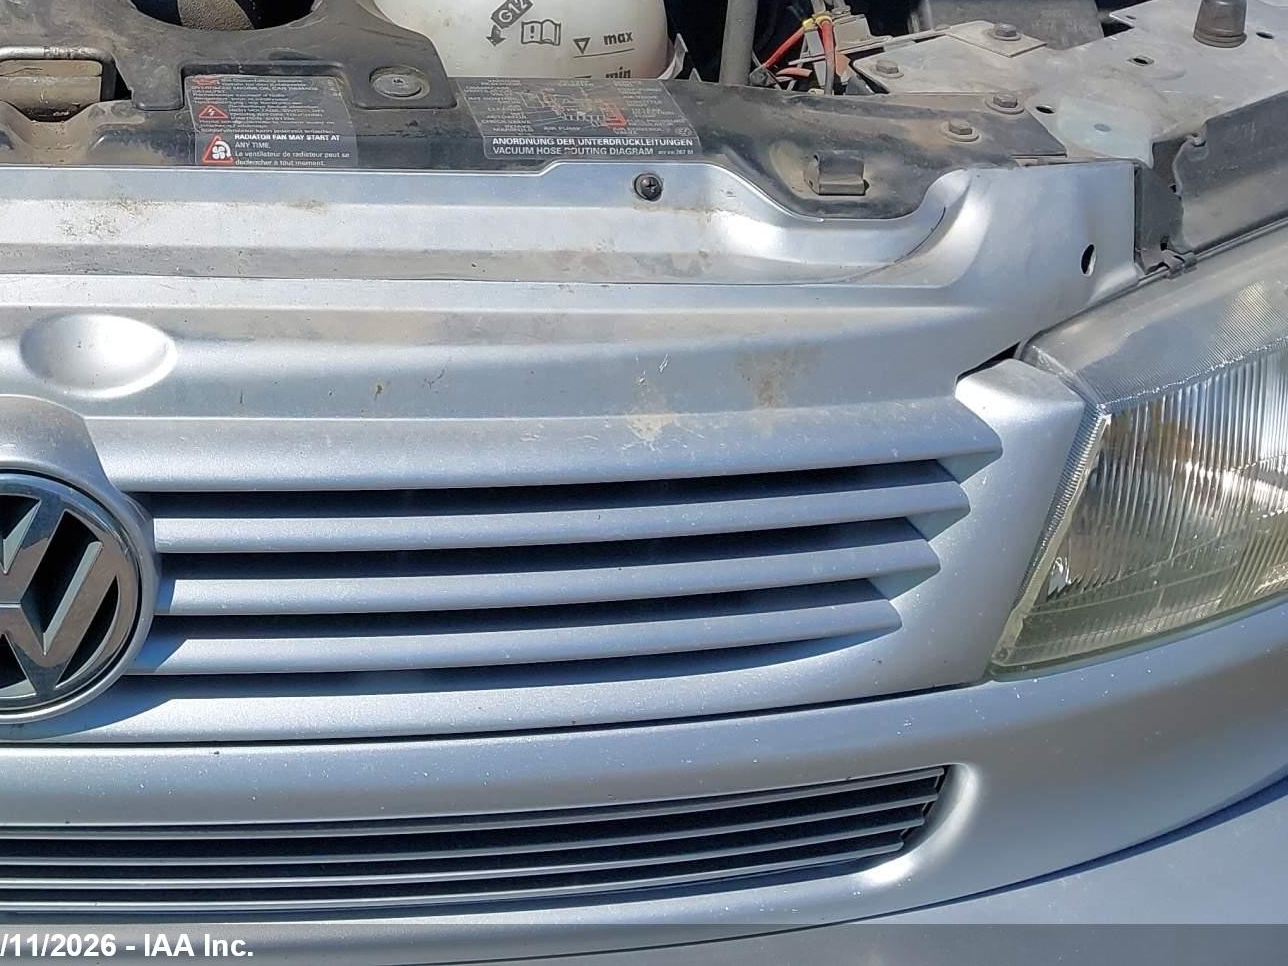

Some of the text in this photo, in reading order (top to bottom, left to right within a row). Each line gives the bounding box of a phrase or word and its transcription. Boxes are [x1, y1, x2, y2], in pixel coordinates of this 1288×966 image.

[603, 32, 633, 45] max
[492, 138, 693, 146] ANORDNUNG DER UNTERDRUCKLEITUNGEN
[492, 147, 534, 155] VACUUM
[536, 147, 562, 155] HOSE
[609, 147, 654, 155] DIAGRAM
